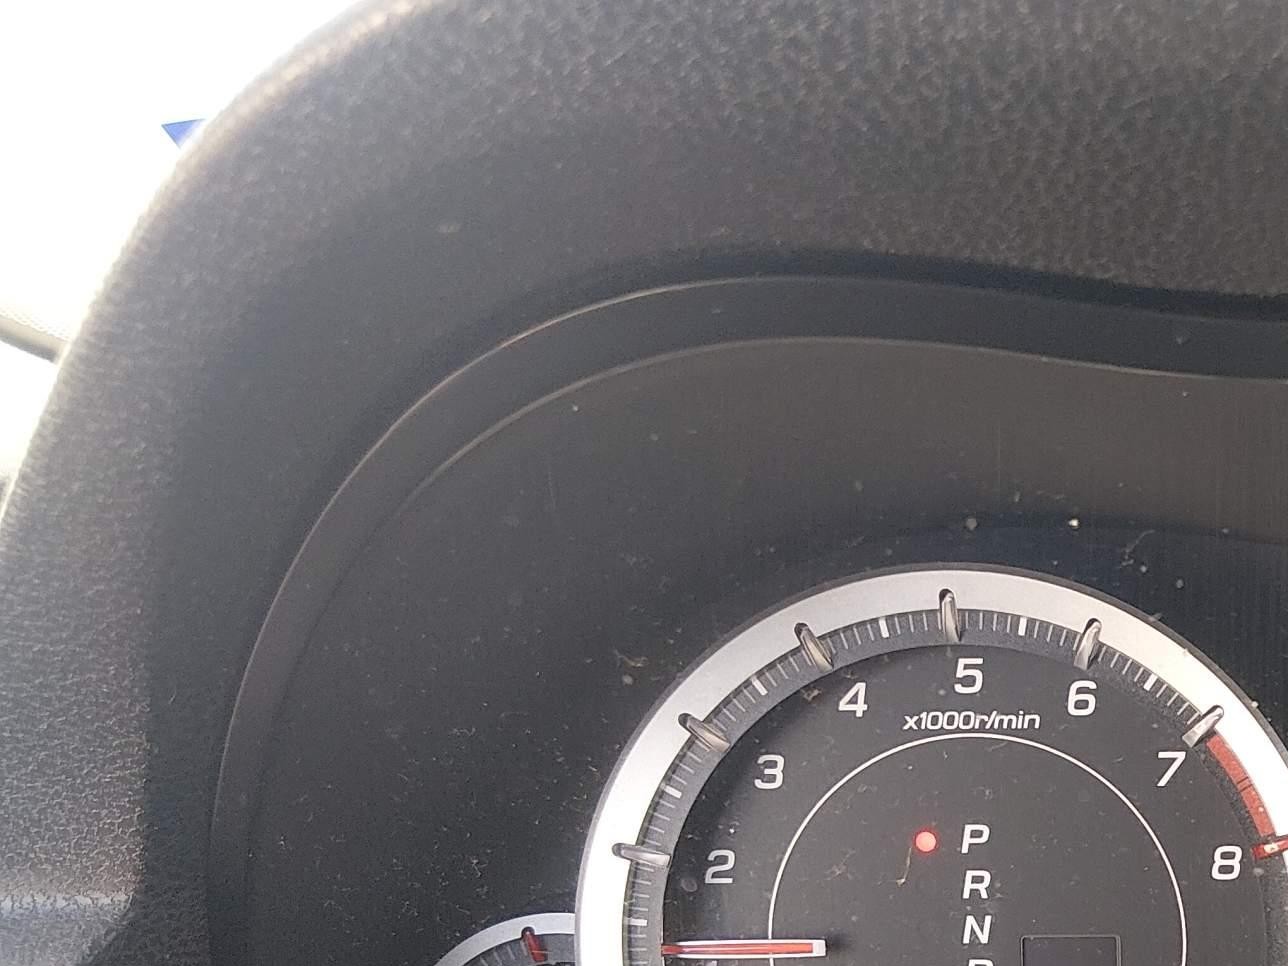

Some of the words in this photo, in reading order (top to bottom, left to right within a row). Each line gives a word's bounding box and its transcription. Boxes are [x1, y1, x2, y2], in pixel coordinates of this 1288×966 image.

[954, 657, 984, 694] 5
[838, 682, 868, 717] 4
[1066, 681, 1096, 716] 6
[902, 711, 1041, 731] x1000r/min
[754, 754, 785, 790] 3
[1156, 752, 1186, 787] 7
[961, 824, 989, 853] P
[704, 849, 735, 884] 2
[1211, 845, 1242, 880] 8
[963, 870, 990, 899] R
[963, 915, 991, 943] N
